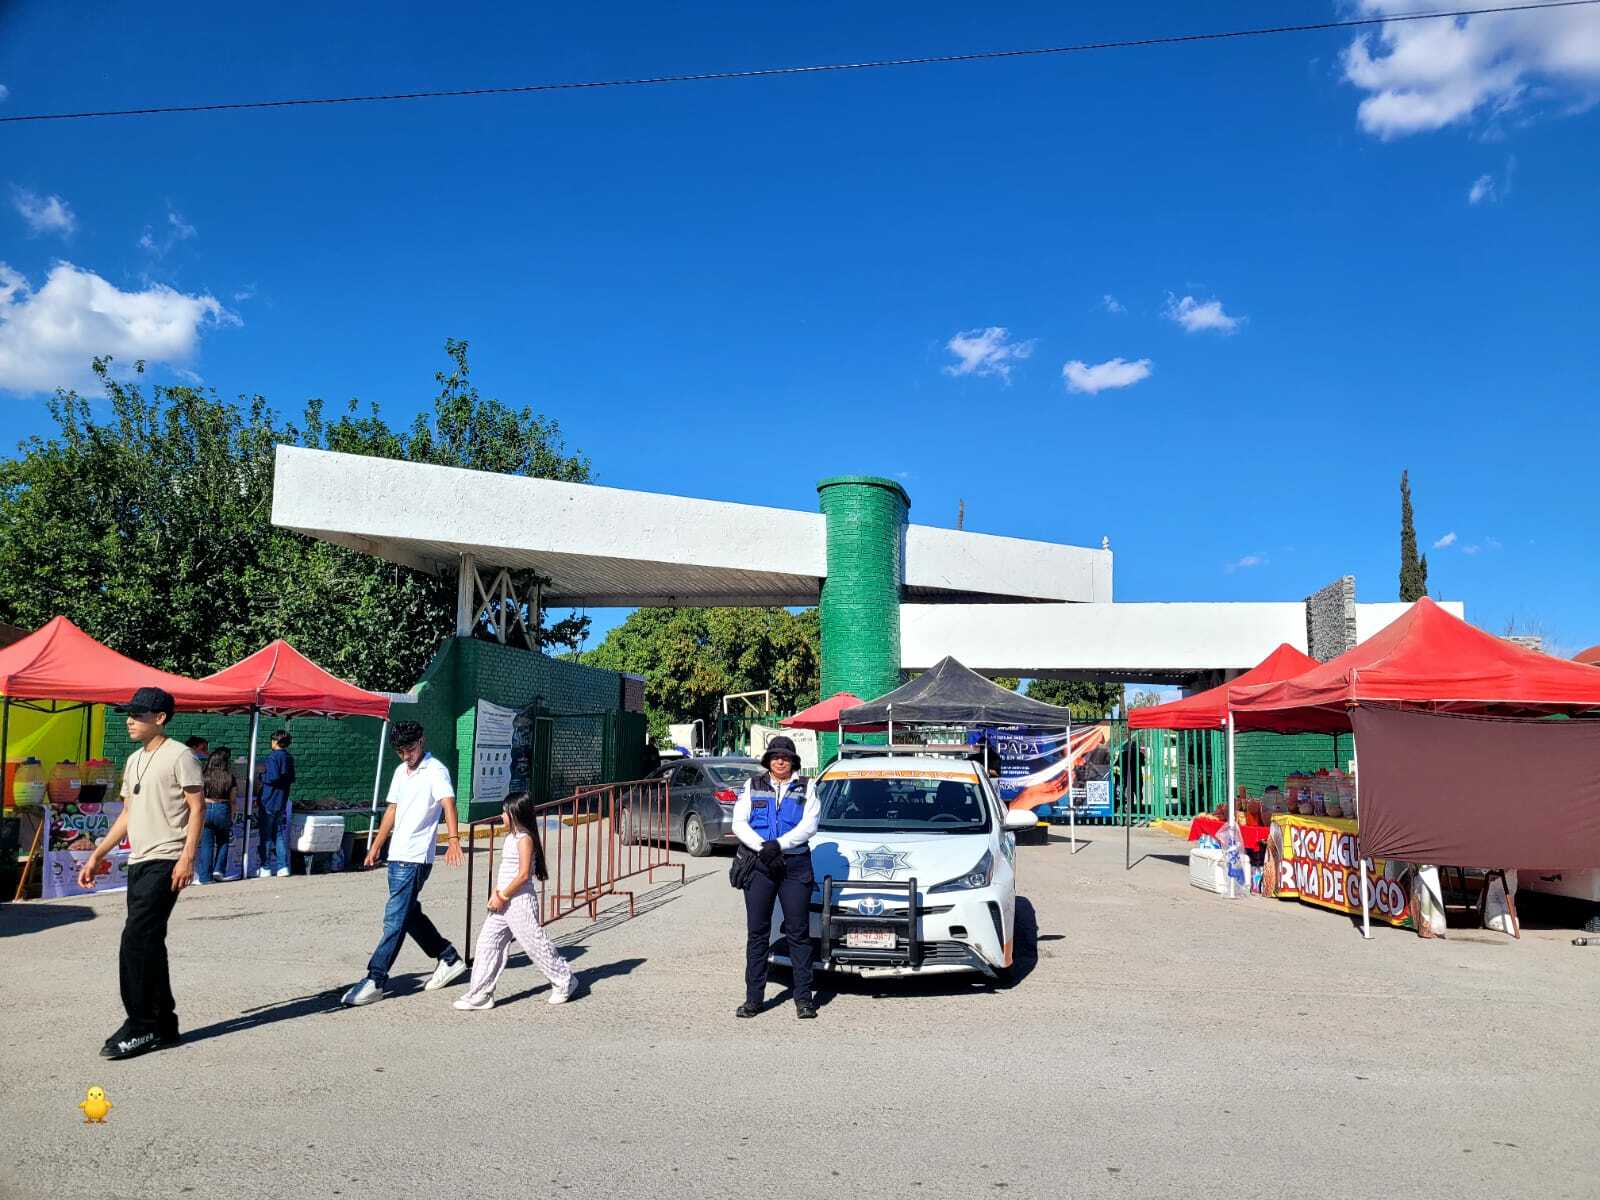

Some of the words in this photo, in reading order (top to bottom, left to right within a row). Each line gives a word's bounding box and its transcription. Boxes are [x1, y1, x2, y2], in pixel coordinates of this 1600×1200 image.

[1291, 827, 1325, 864] RICA
[1328, 834, 1374, 872] AGU
[1323, 867, 1344, 902] DE
